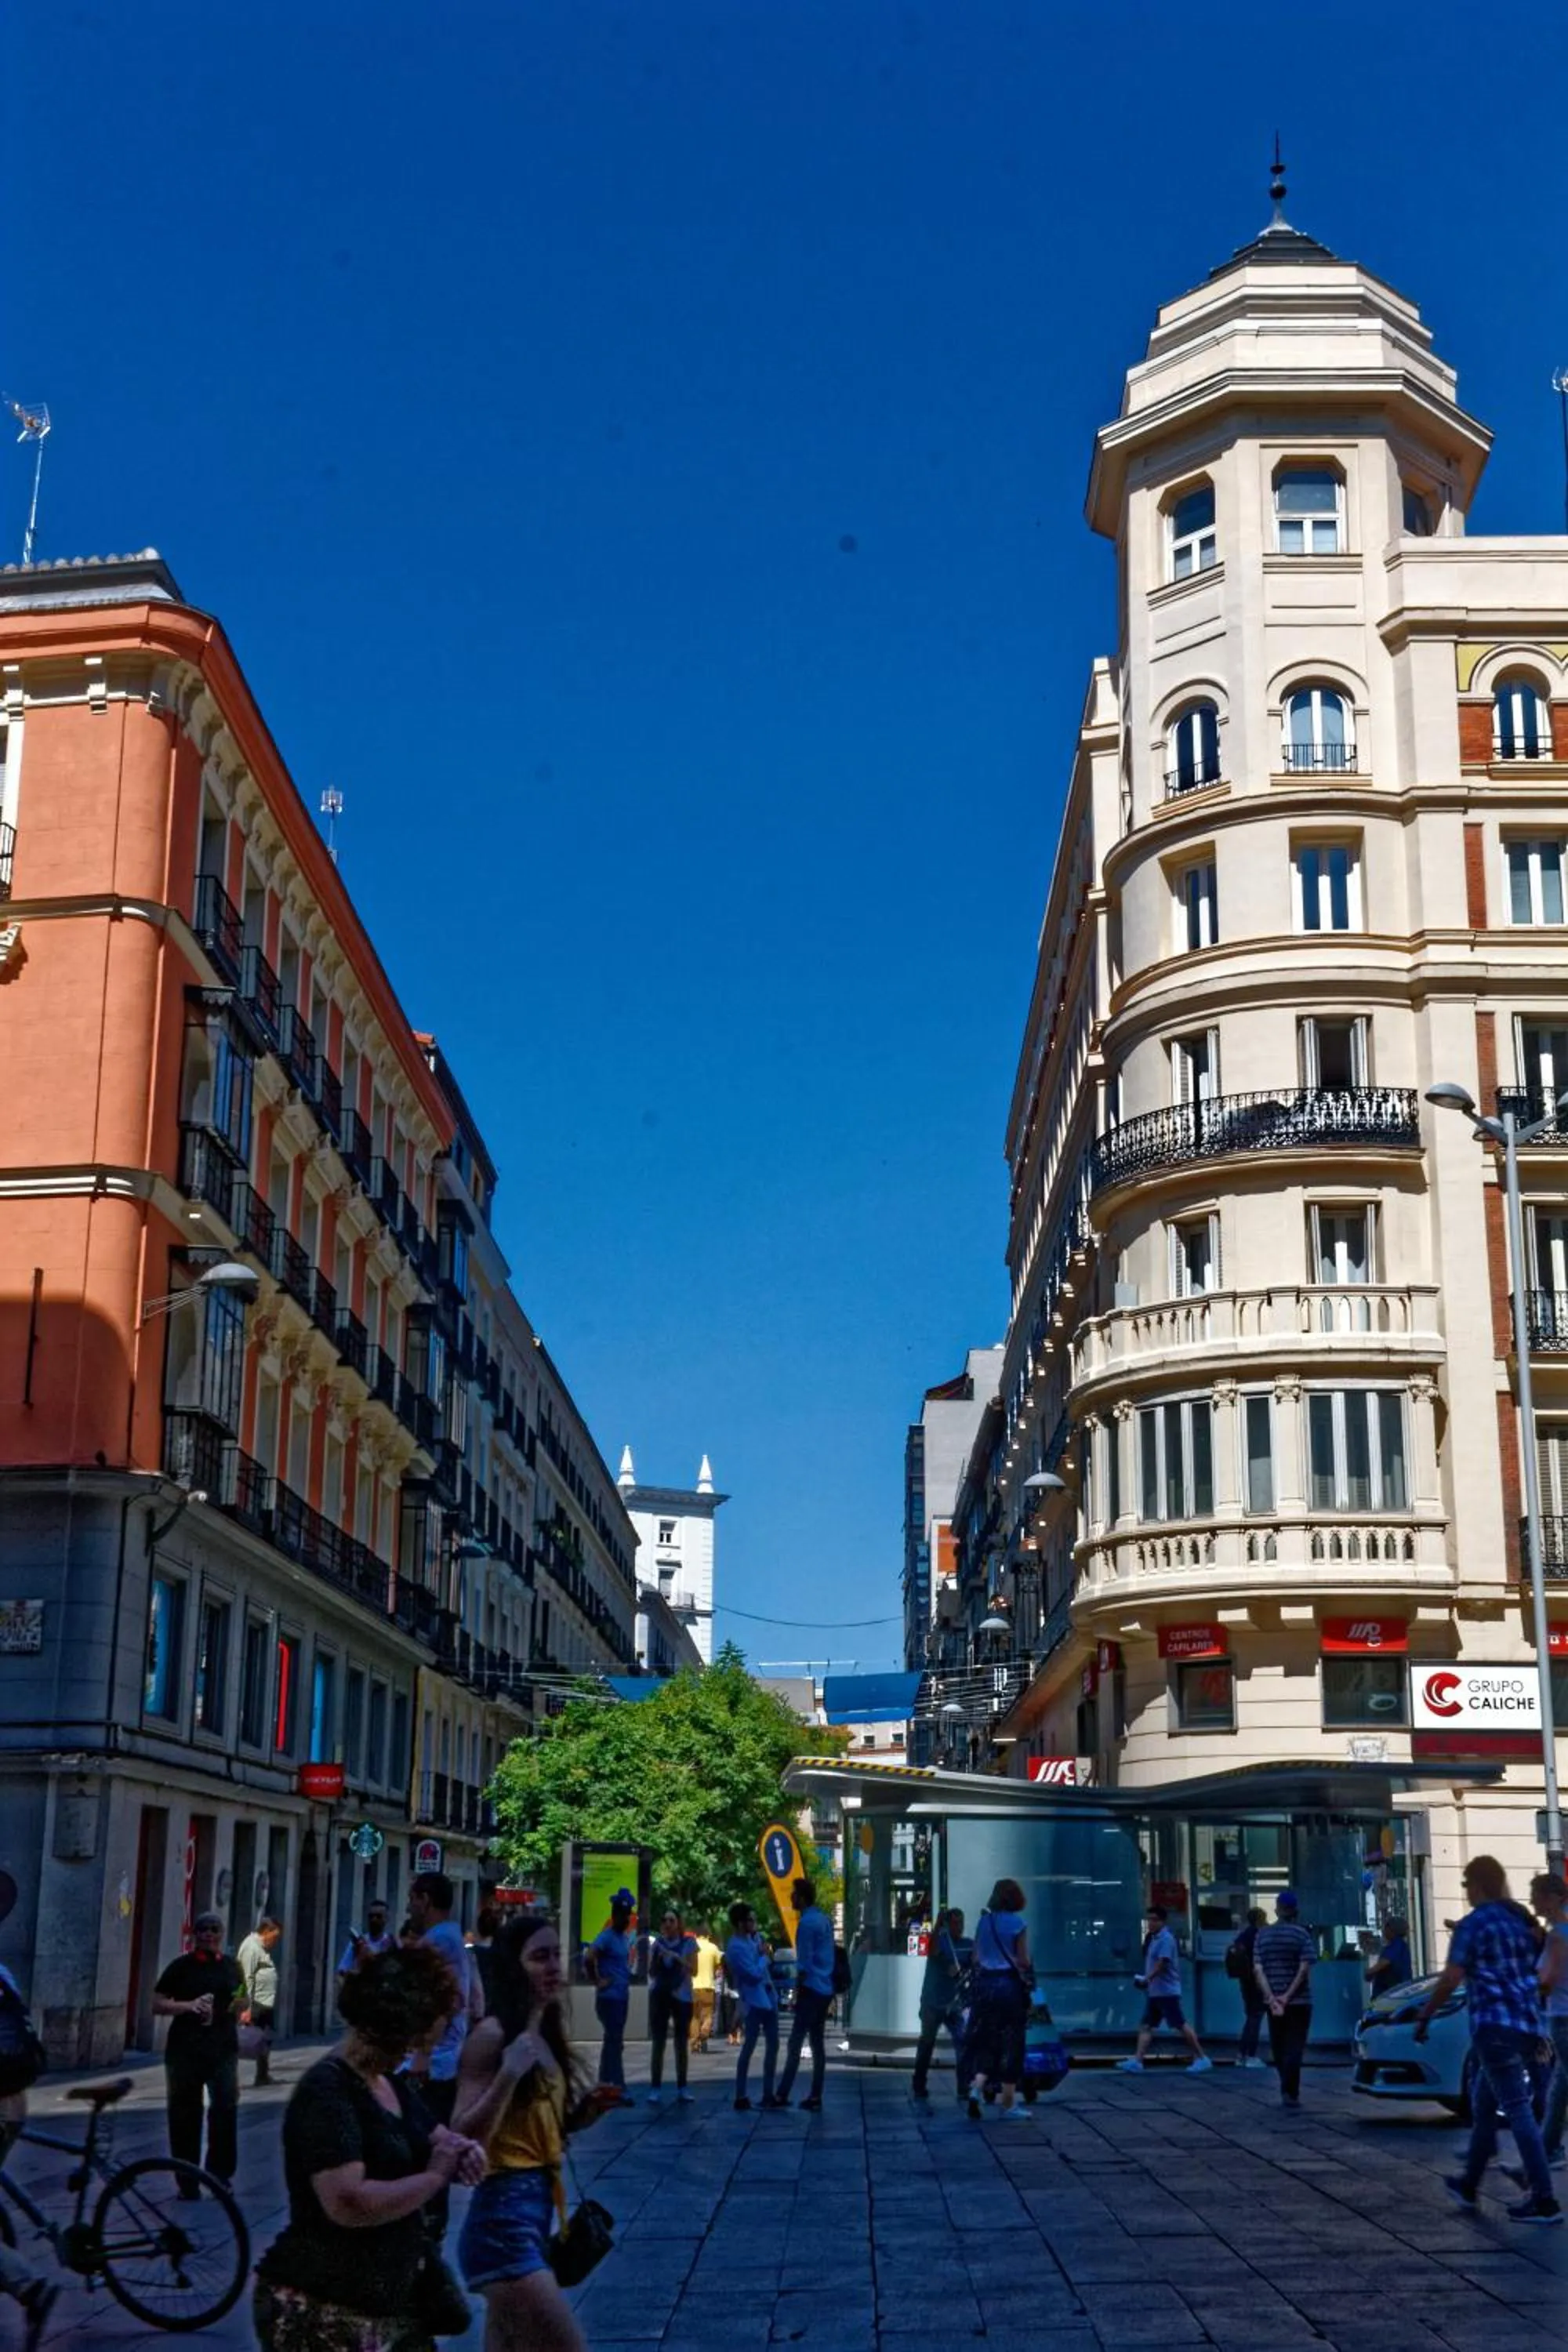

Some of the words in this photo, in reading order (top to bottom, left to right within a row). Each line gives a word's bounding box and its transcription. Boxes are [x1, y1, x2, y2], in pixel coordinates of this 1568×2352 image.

[1169, 1628, 1210, 1640] CENTROS
[1467, 1679, 1523, 1693] GRUPO
[1468, 1697, 1535, 1710] CALICHE
